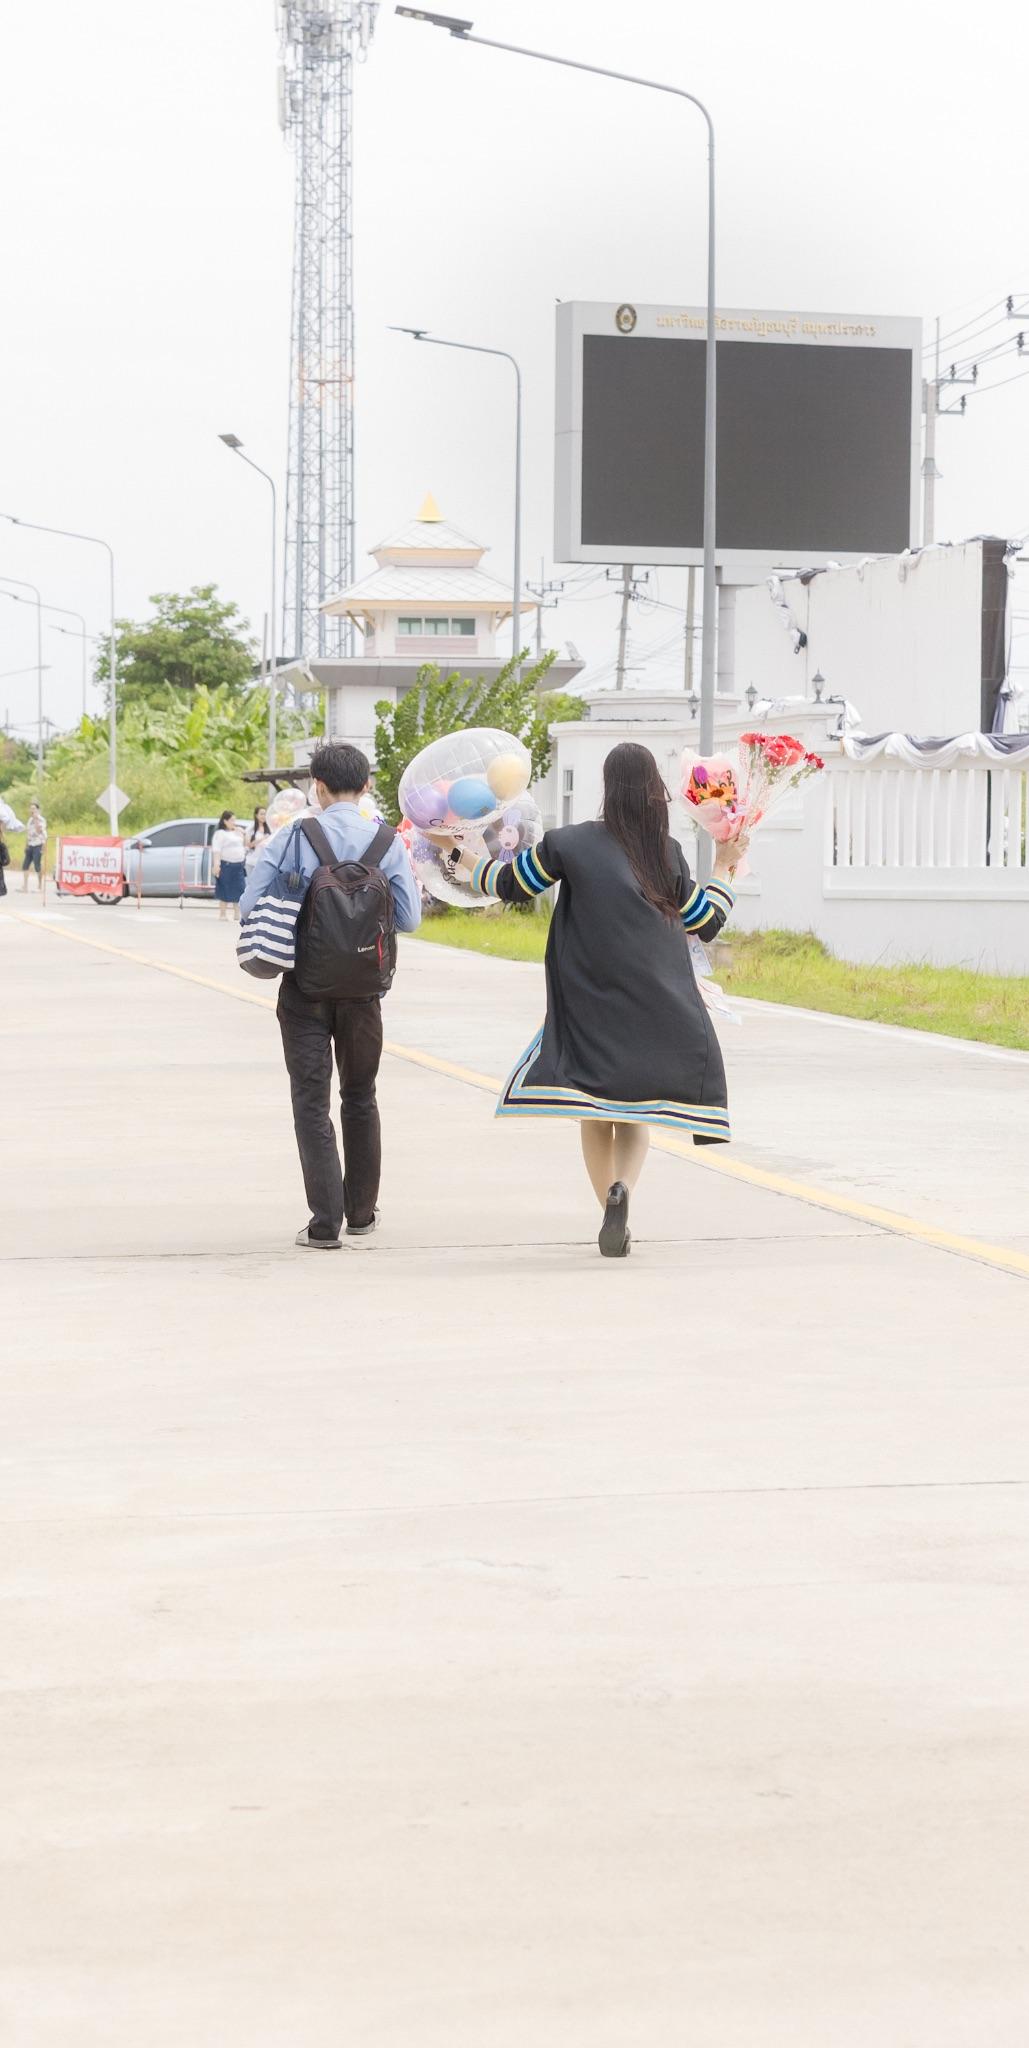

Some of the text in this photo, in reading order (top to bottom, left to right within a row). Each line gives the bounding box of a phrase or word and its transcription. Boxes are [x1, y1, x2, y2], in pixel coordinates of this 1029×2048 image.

[67, 849, 118, 868] ห้ามเข้า
[62, 871, 120, 888] No Entry
[357, 944, 376, 953] Lenovo
